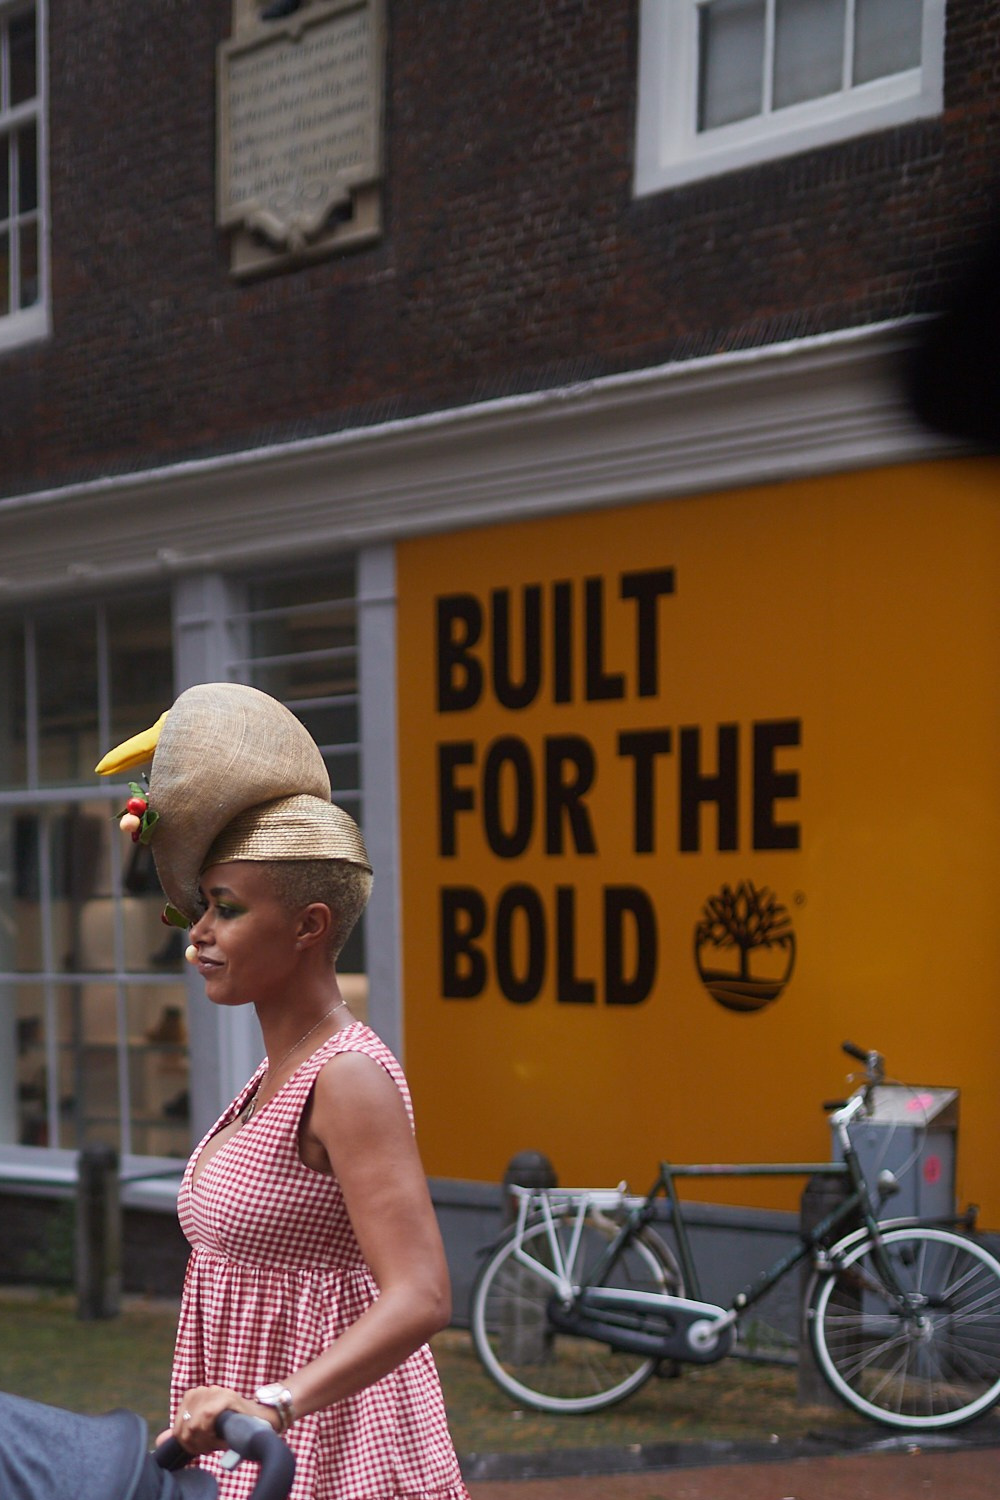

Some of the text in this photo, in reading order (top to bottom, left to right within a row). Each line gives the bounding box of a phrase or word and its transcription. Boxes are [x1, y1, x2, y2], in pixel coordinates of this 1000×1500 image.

[435, 567, 676, 714] BUILT
[437, 719, 801, 860] FOR THE
[441, 881, 658, 1006] BOLD
